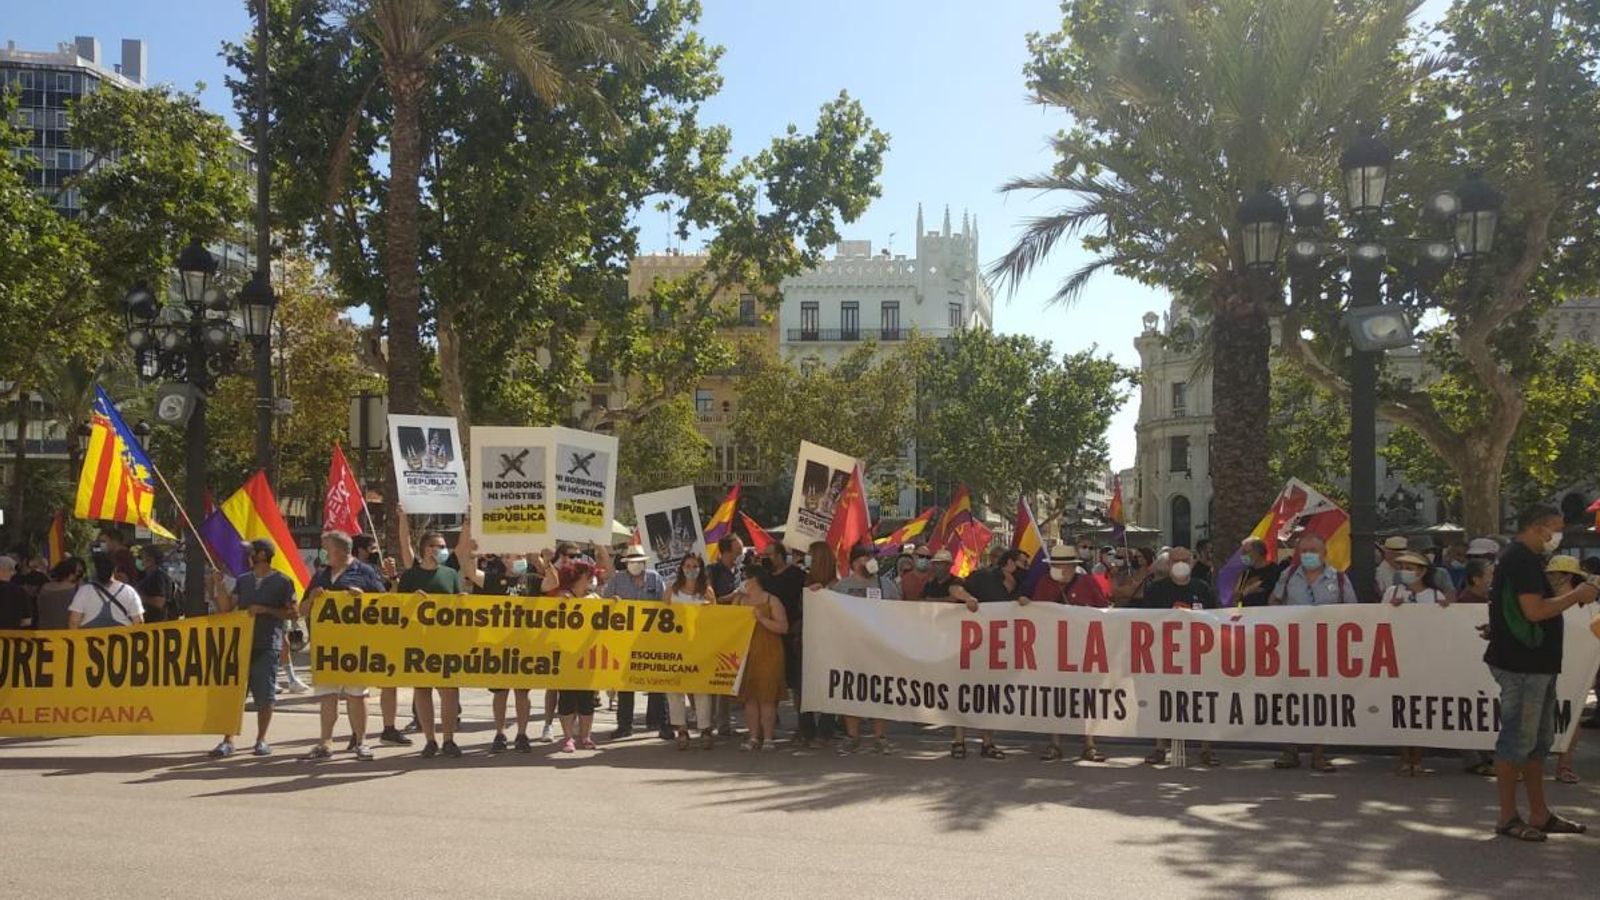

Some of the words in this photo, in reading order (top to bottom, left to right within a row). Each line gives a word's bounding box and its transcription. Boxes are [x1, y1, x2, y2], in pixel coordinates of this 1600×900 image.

[482, 481, 494, 490] NI
[488, 491, 499, 500] NI
[317, 597, 409, 629] Adéu,
[417, 599, 585, 631] Constitució
[591, 604, 635, 632] del
[641, 608, 684, 634] 78.
[63, 637, 74, 688] I
[85, 626, 241, 689] SOBIRANA
[316, 645, 396, 677] Hola,
[404, 647, 561, 679] República!
[631, 650, 683, 662] ESQUERRA
[959, 618, 1037, 670] PER
[1057, 620, 1110, 674] LA
[1130, 615, 1400, 679] REPÚBLICA
[630, 661, 699, 674] REPUBLICANA
[829, 668, 949, 711] PROCESSOS
[958, 682, 1127, 721] CONSTITUENTS
[1159, 690, 1219, 725] DRET
[1229, 692, 1245, 726] A
[1254, 693, 1357, 728] DECIDIR
